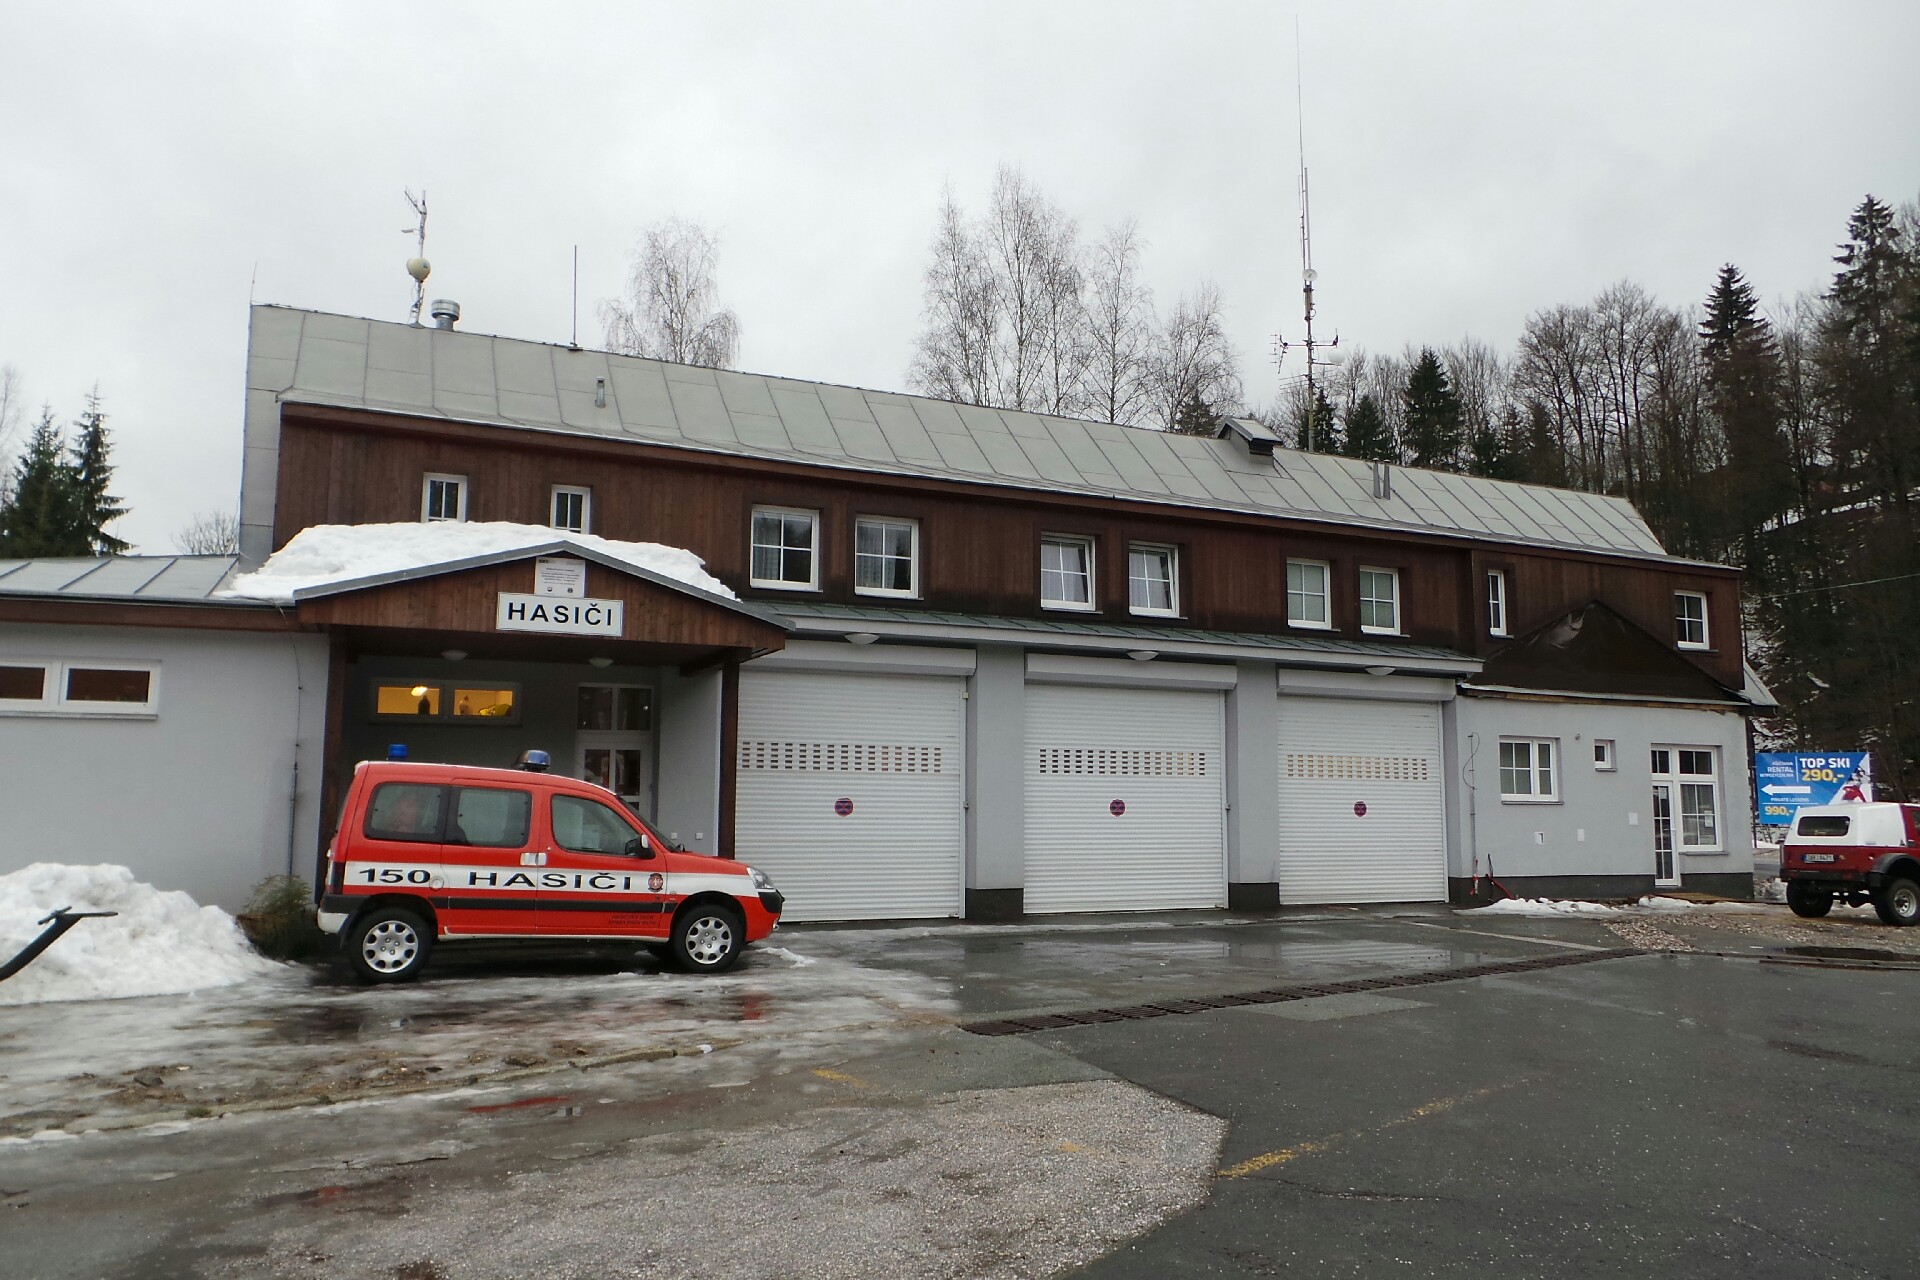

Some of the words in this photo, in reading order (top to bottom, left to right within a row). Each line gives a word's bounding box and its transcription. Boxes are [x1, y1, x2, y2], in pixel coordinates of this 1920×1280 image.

[508, 602, 611, 626] HASIČI
[1799, 757, 1826, 769] TOP
[1828, 758, 1851, 769] SKI
[1801, 768, 1845, 784] 290,-
[359, 868, 431, 884] 150
[468, 872, 631, 891] HASIČI
